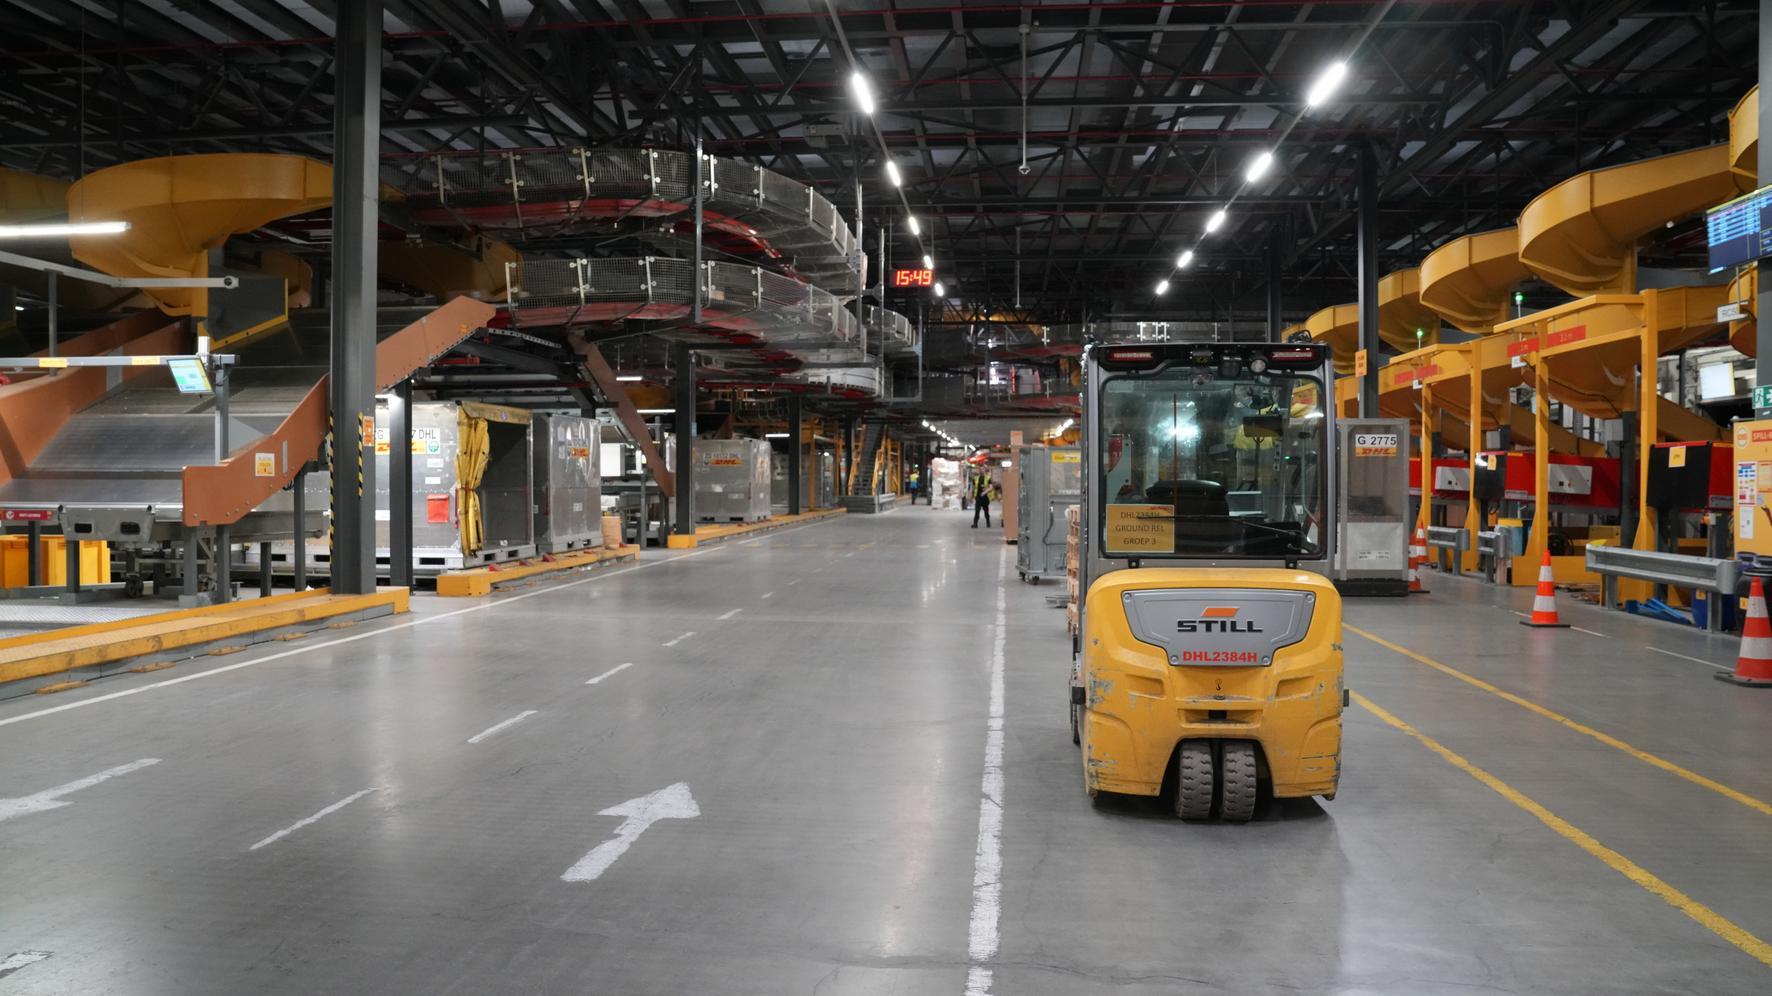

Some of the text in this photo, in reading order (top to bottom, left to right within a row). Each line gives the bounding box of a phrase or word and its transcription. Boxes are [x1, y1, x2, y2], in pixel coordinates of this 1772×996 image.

[896, 270, 932, 286] 15:49
[419, 430, 437, 440] DHL
[1357, 436, 1396, 445] G 2775
[1123, 537, 1150, 545] GROEP
[1177, 620, 1263, 633] STILL
[1183, 651, 1258, 662] DHL2384H
